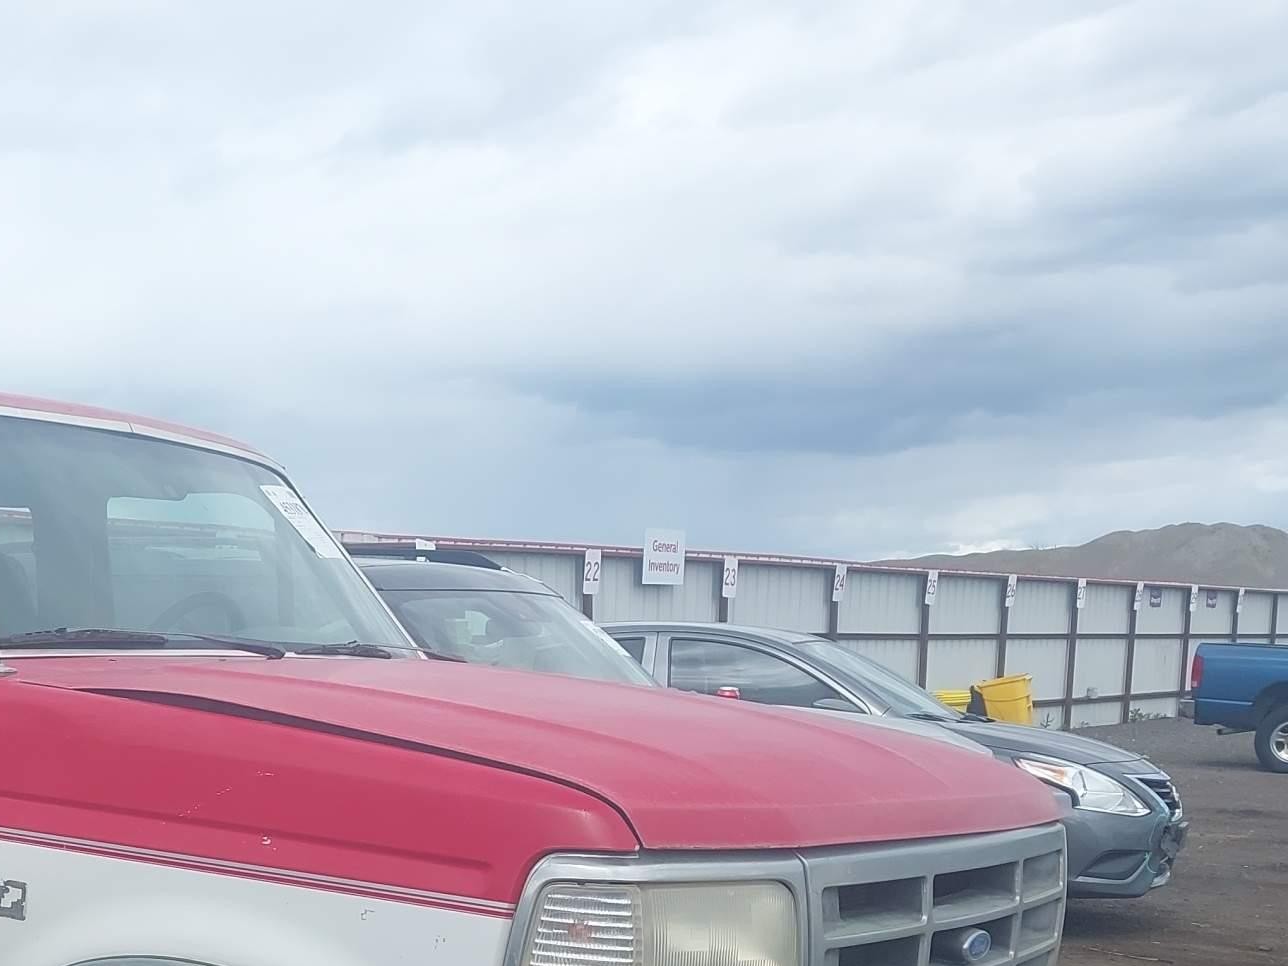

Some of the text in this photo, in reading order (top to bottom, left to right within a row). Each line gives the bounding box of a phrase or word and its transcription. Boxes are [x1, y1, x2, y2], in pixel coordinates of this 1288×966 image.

[652, 540, 679, 553] General
[585, 561, 600, 582] 22
[648, 559, 680, 575] Inventory
[724, 567, 737, 587] 23
[834, 574, 846, 591] 24
[927, 580, 937, 595] 25
[1006, 583, 1016, 598] 26
